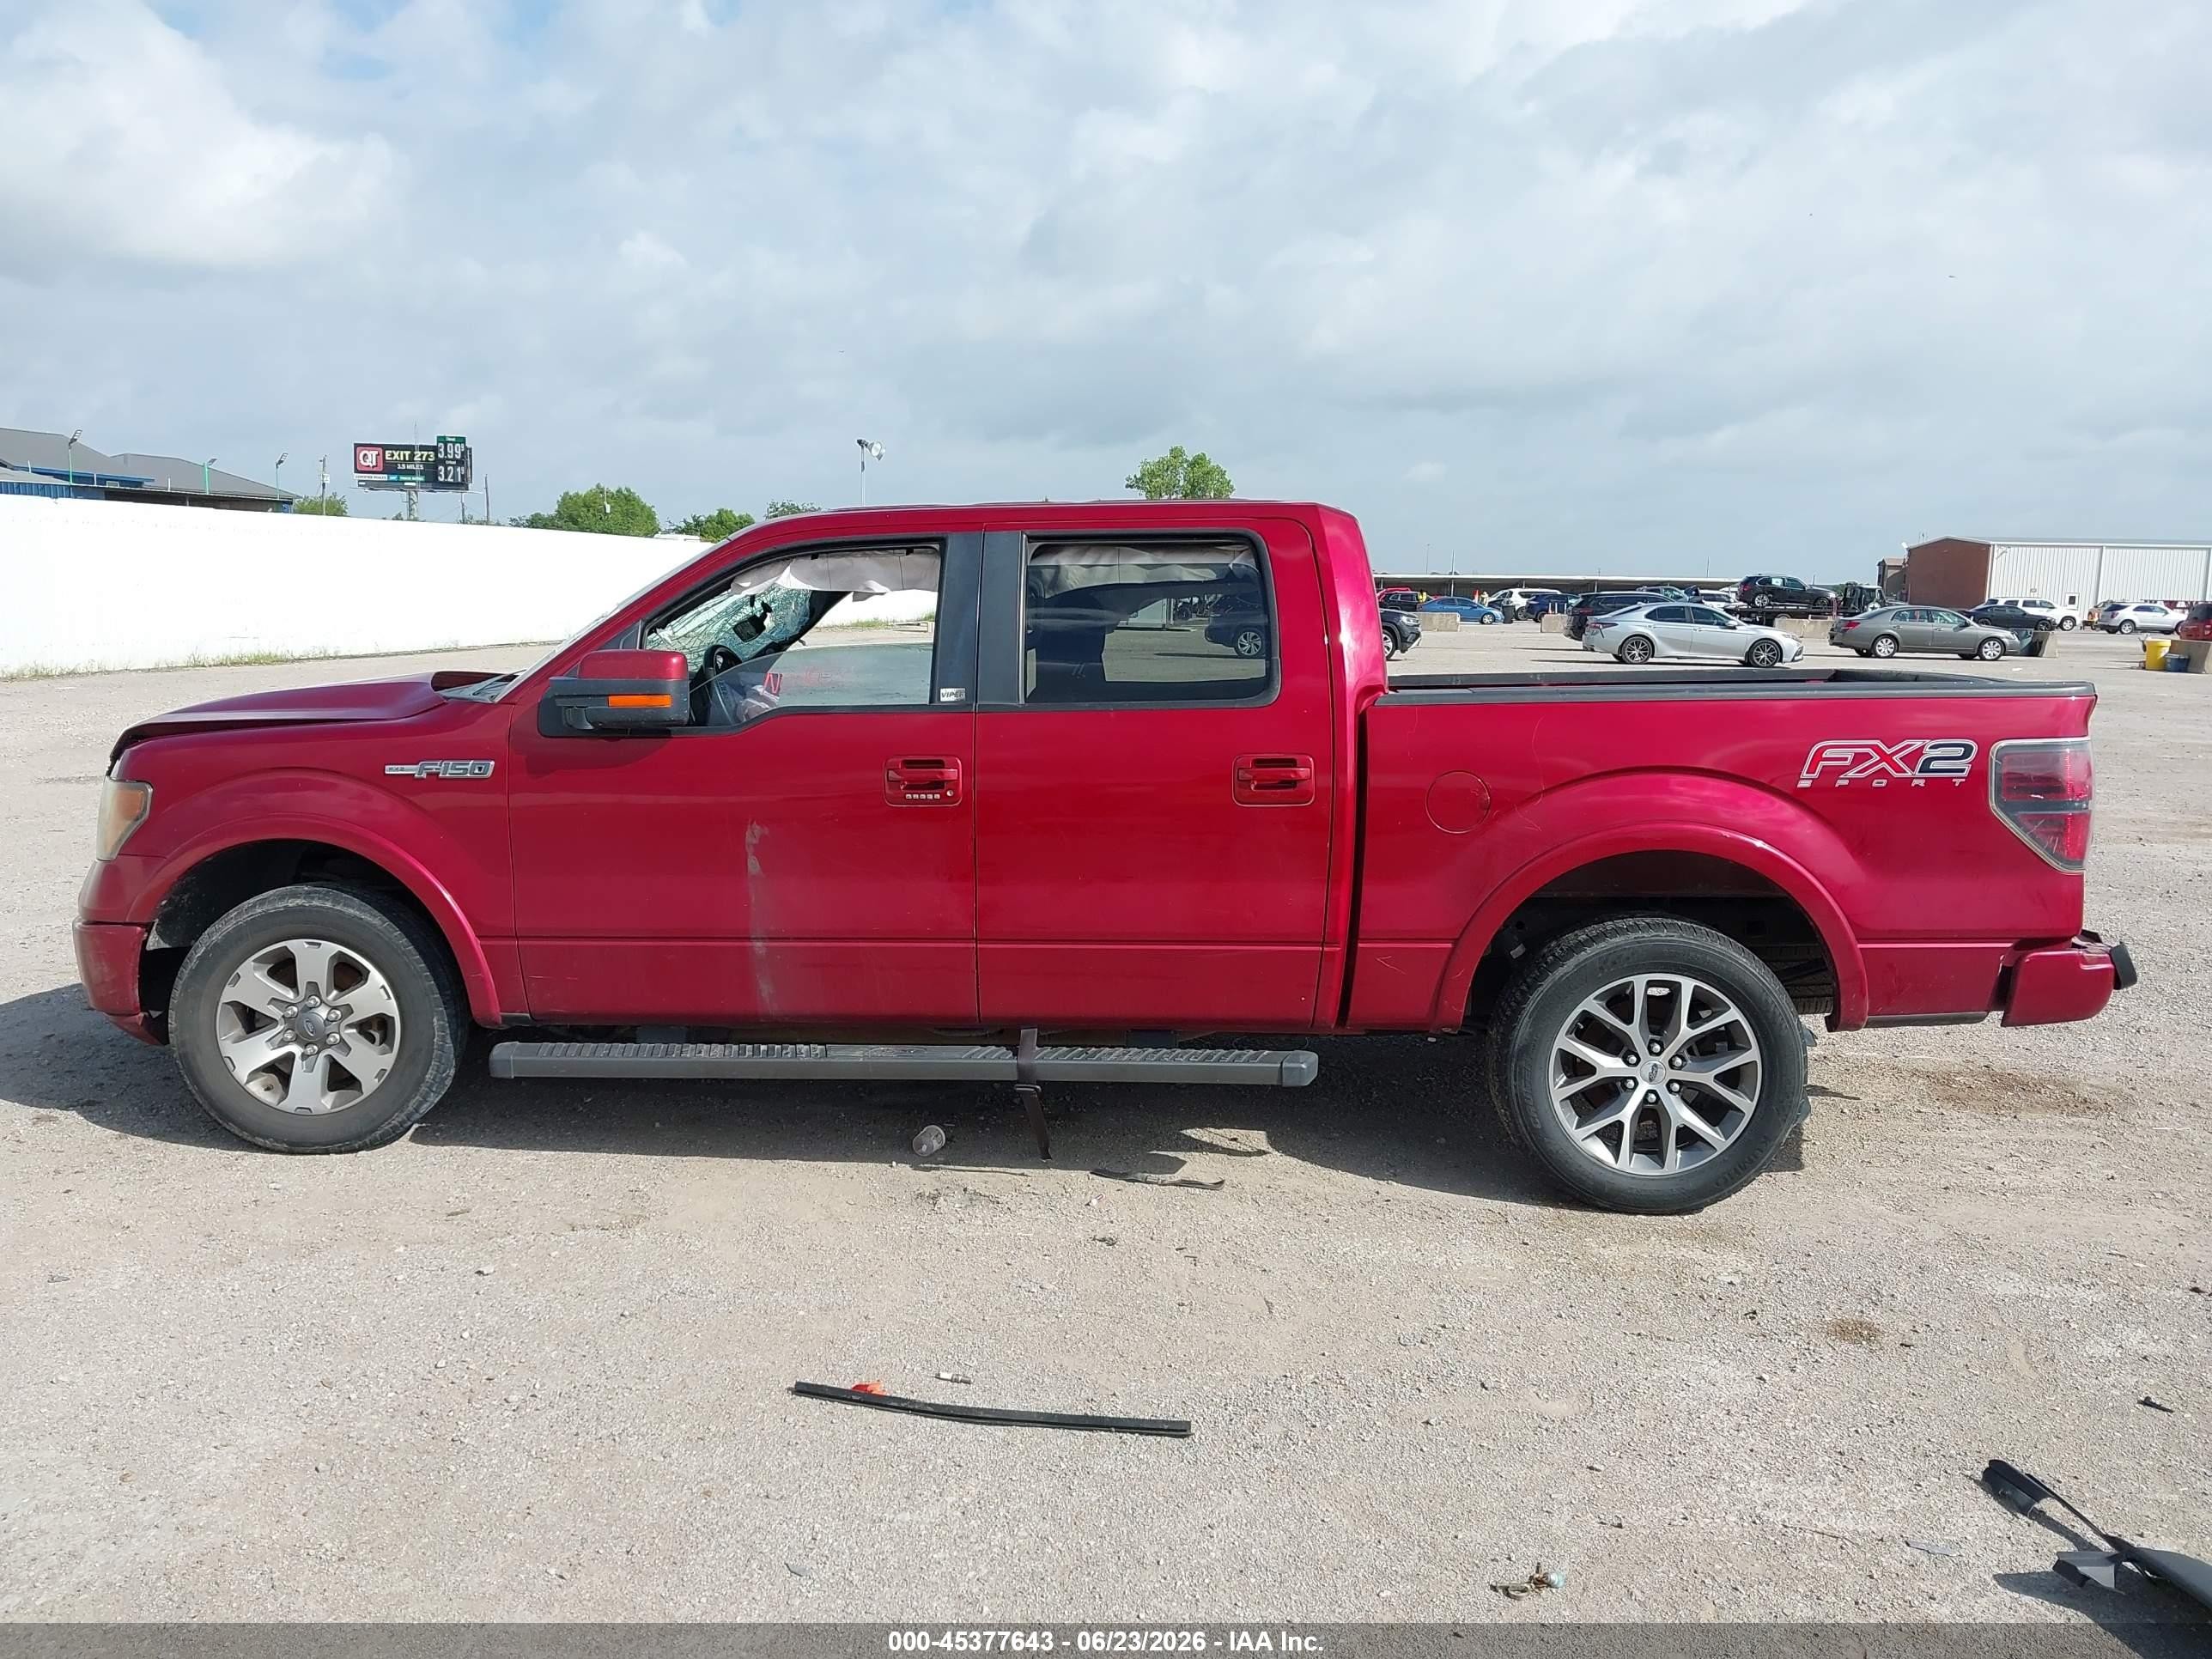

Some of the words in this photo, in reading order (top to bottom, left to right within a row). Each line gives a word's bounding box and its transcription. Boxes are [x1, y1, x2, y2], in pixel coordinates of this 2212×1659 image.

[359, 450, 379, 468] QT
[385, 450, 411, 461] EXIT
[413, 451, 435, 462] 273
[1800, 738, 1978, 779] FX2
[1796, 779, 1966, 788] SPORT
